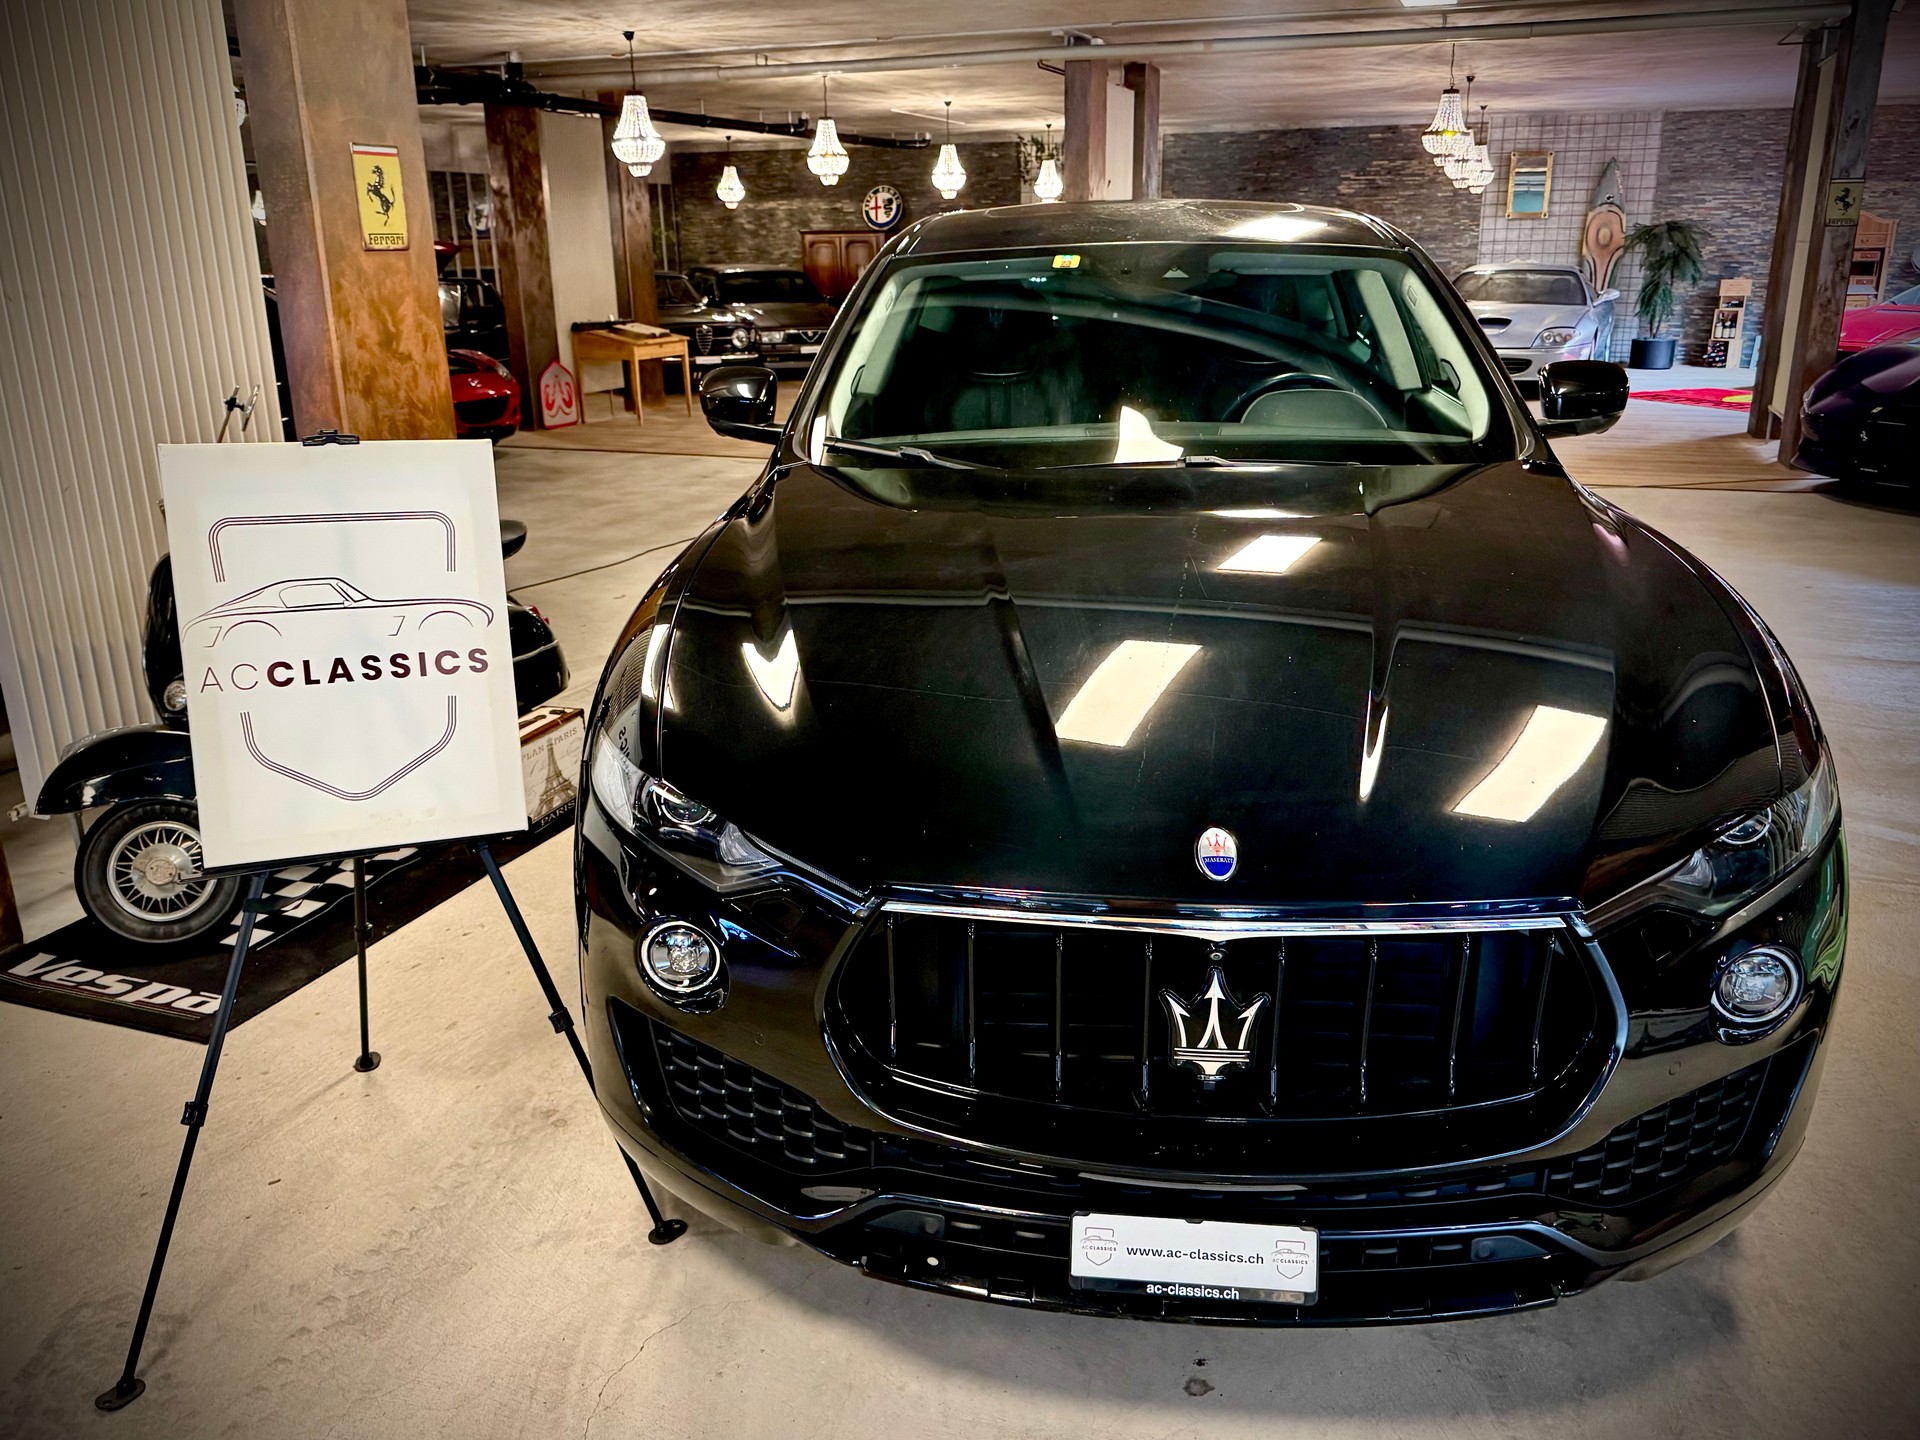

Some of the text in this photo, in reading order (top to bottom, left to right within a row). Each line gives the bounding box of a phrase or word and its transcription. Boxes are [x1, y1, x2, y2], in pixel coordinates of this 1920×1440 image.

[368, 233, 405, 246] Ferrari
[553, 727, 578, 746] PARIS
[541, 799, 577, 826] PARIS
[7, 952, 223, 1015] Vespa
[1126, 1246, 1265, 1266] www.ac-classics.ch
[1146, 1283, 1240, 1300] ac-classics.ch
